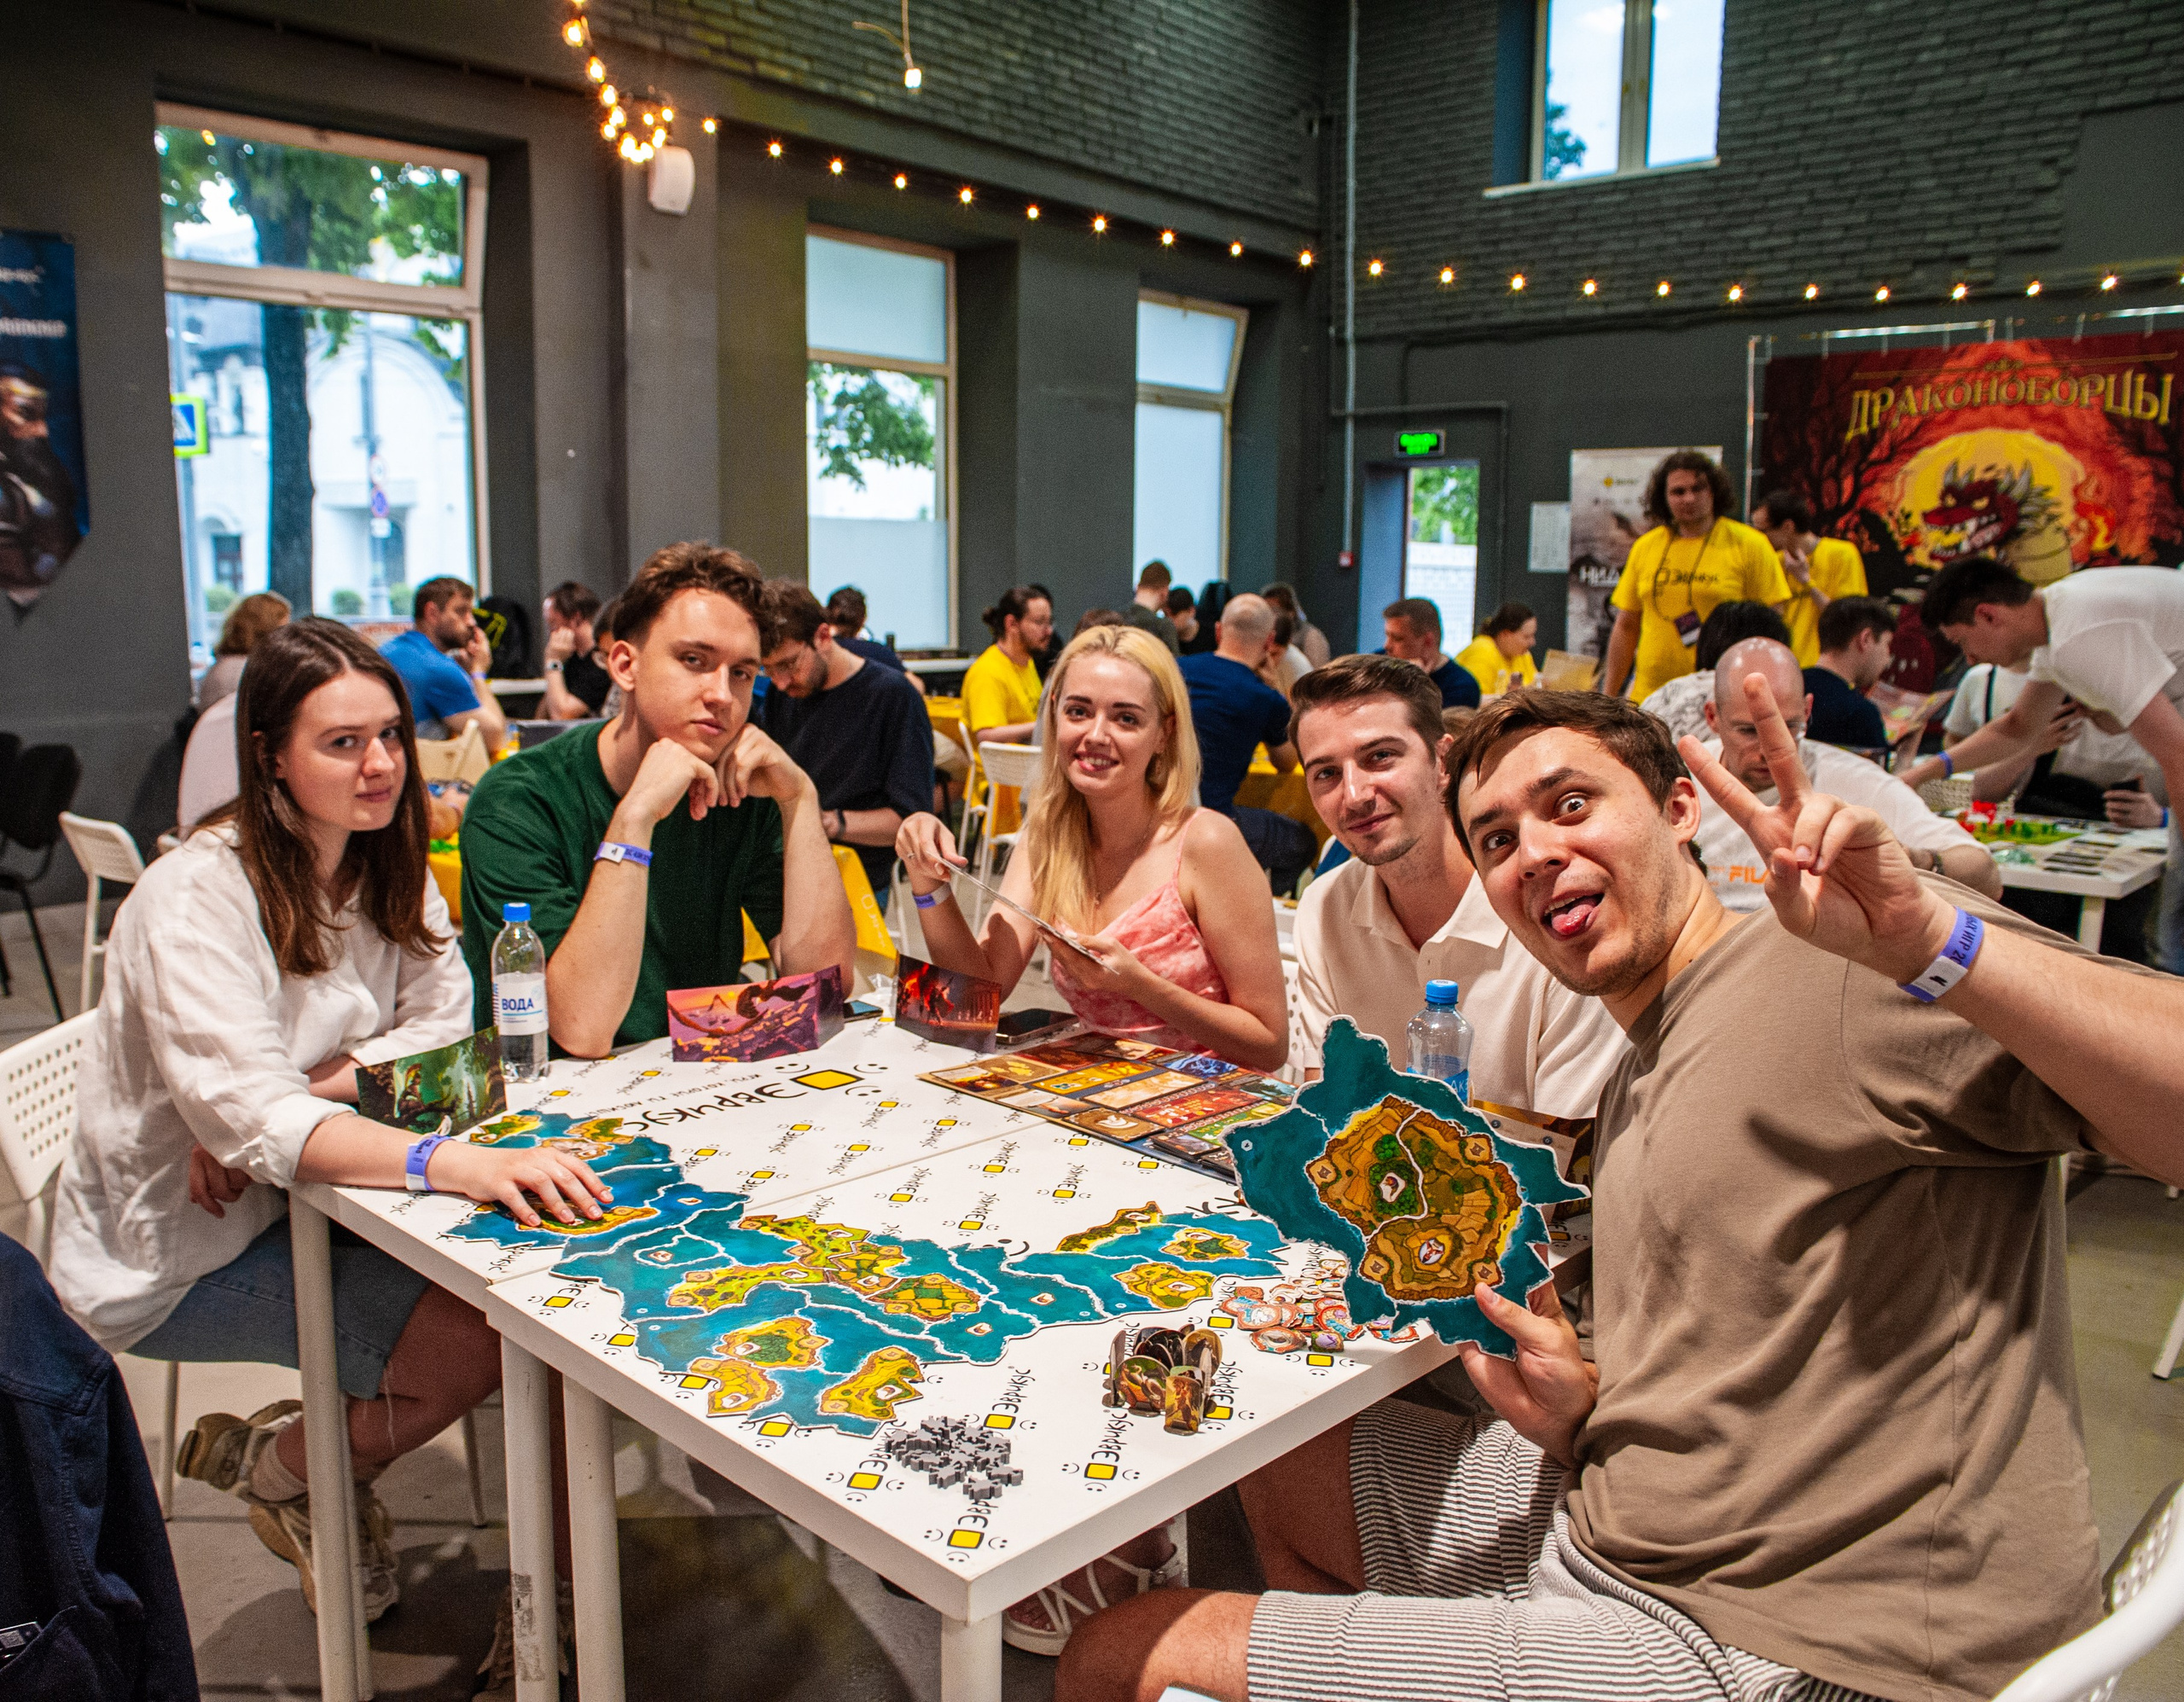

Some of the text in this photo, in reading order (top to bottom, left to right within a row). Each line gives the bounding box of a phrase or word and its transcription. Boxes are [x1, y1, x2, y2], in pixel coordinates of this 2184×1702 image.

[1844, 368, 2175, 443] ДРАКОНОБОРЦЫ
[502, 998, 534, 1011] ВОДА
[623, 1083, 808, 1131] Эврикус
[992, 1368, 1036, 1413] Эврикус
[1091, 1413, 1134, 1462] Эврикус
